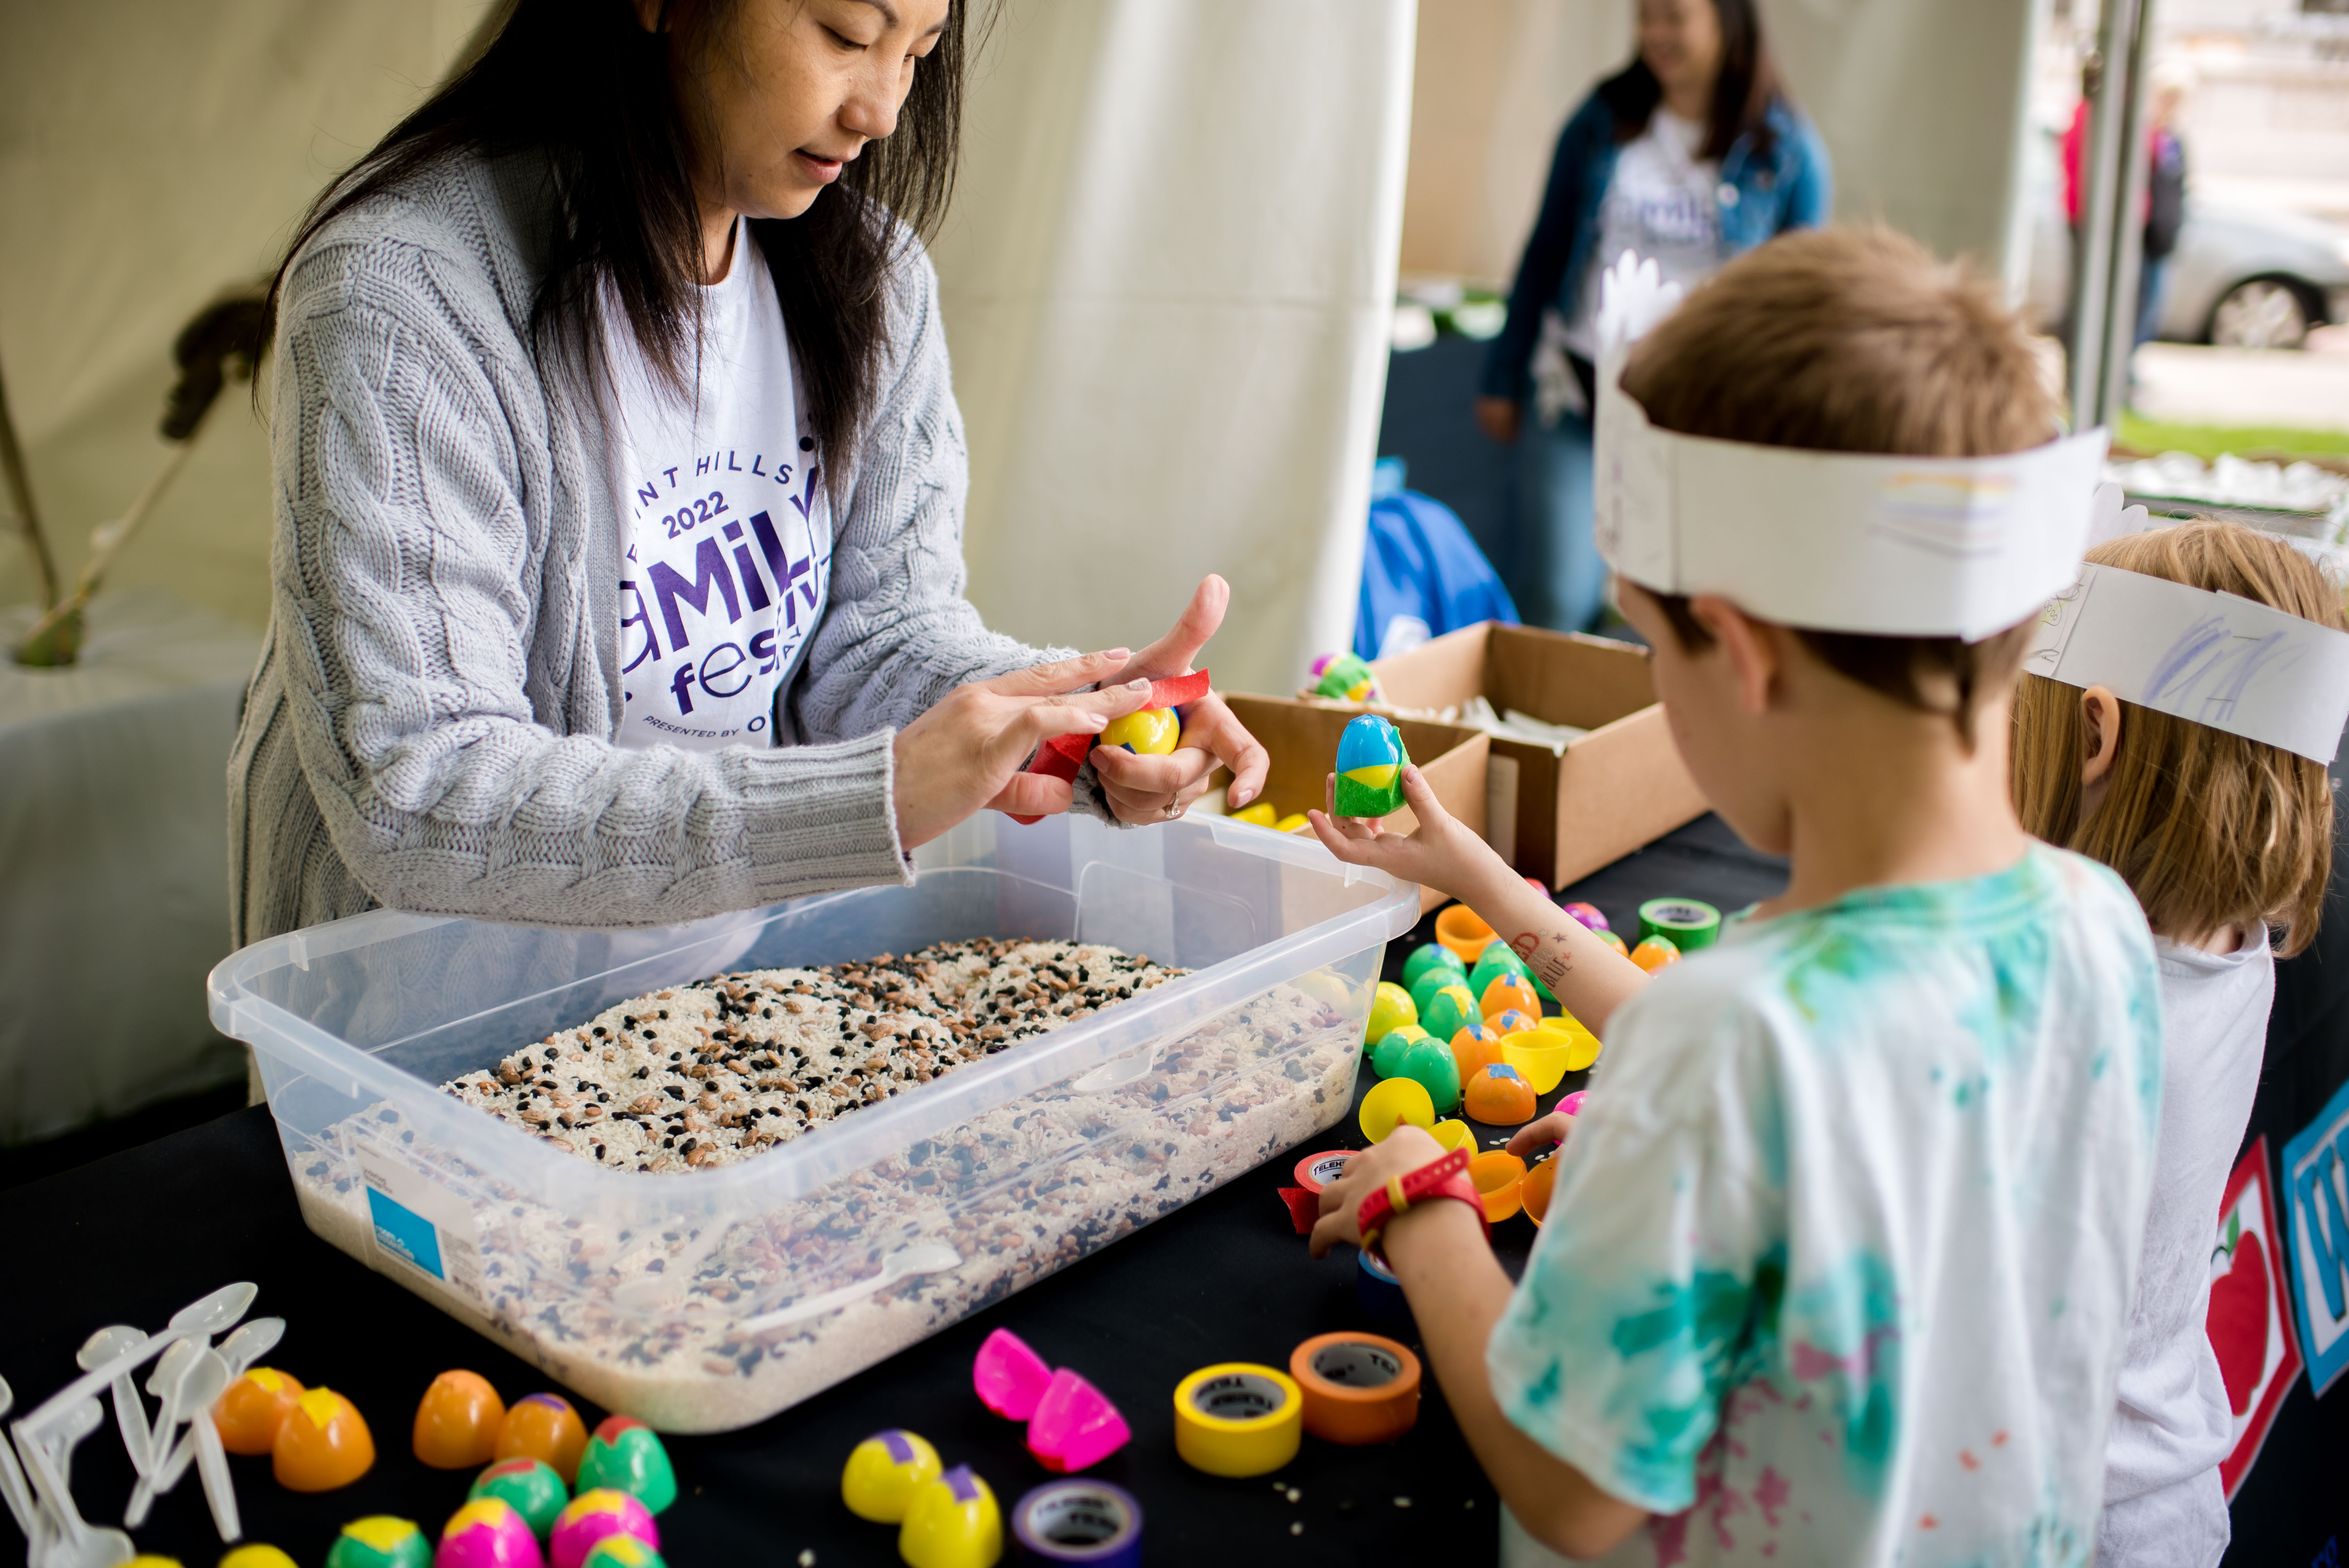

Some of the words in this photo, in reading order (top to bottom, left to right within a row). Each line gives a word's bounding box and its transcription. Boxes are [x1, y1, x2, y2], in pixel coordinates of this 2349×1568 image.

[696, 450, 793, 485] HILLS
[661, 491, 729, 540] 2022
[643, 715, 716, 738] PRESENTED
[721, 728, 740, 737] BY
[1541, 957, 1572, 988] BLUE
